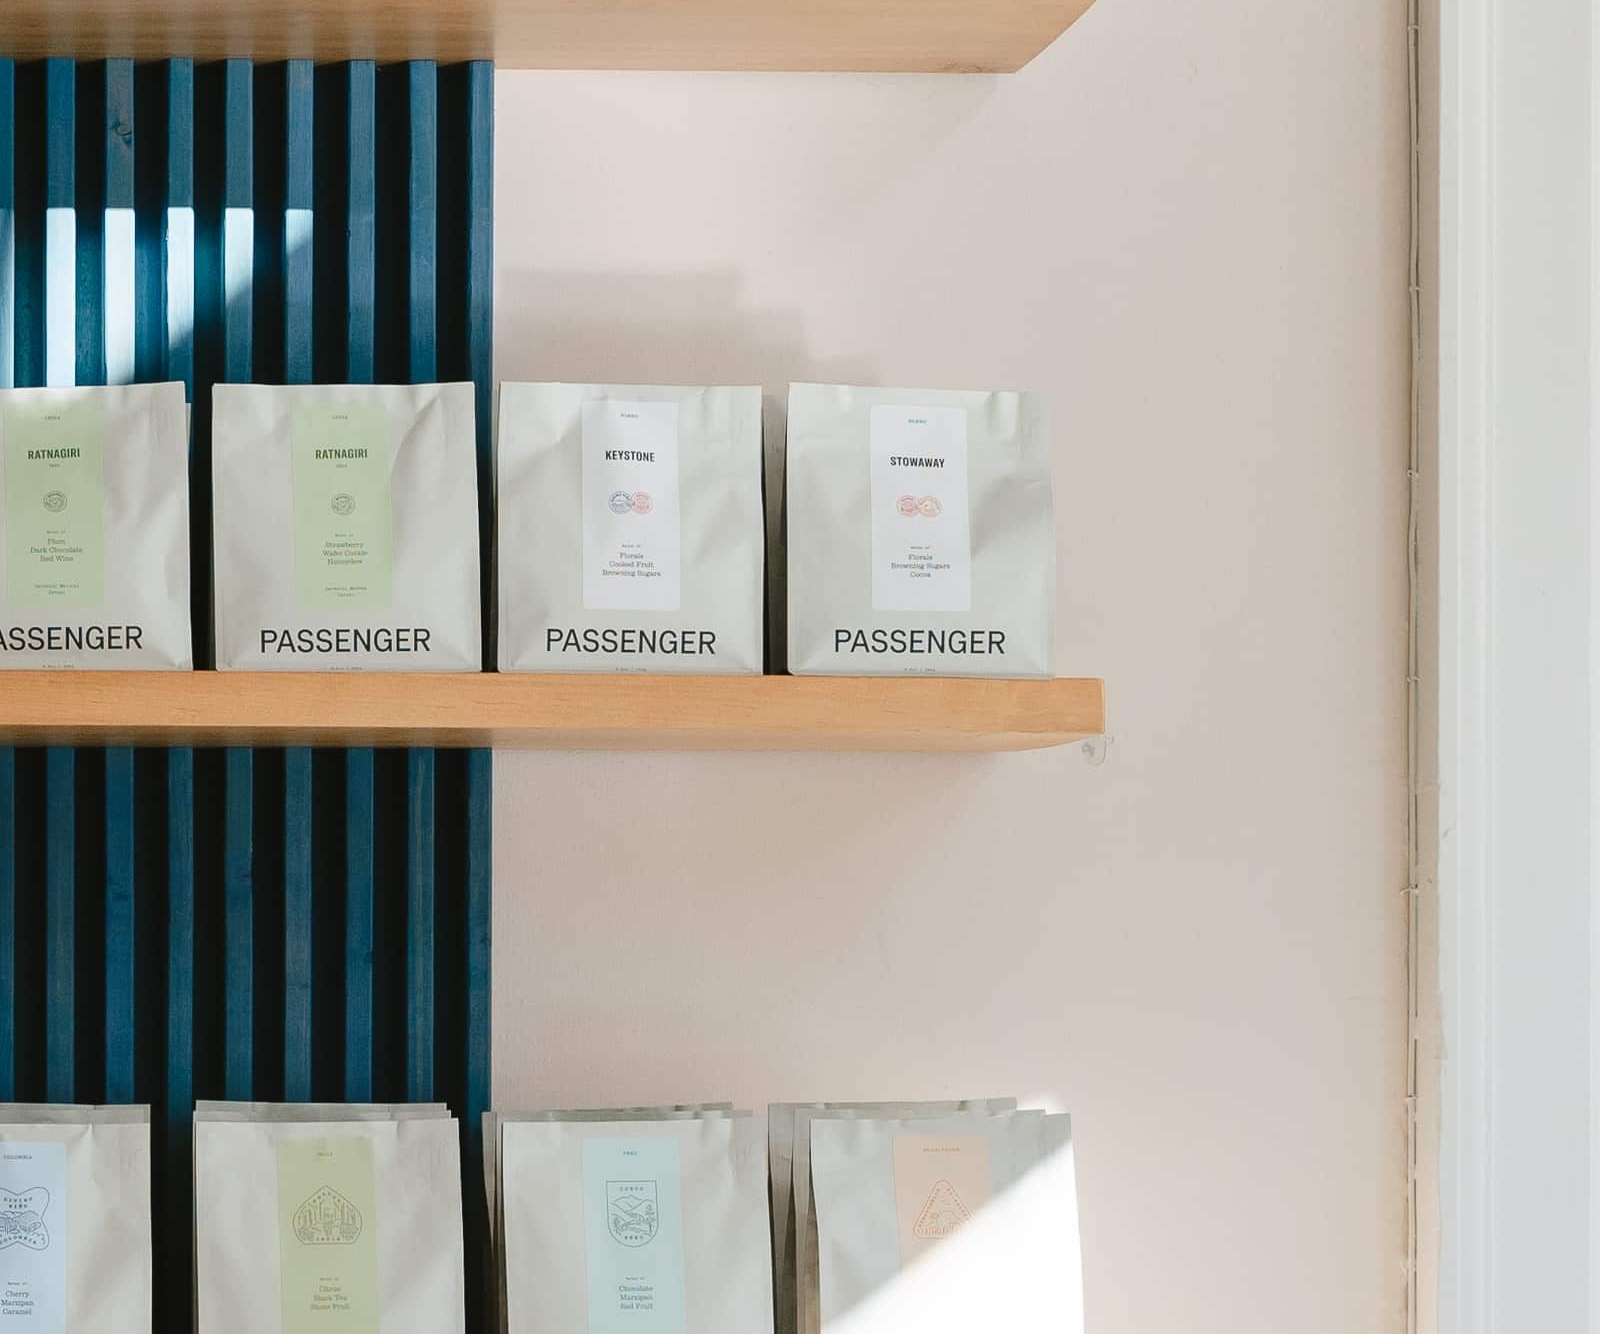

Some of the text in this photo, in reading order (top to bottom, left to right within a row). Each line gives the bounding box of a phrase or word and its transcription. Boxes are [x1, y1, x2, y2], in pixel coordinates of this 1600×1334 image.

[28, 448, 80, 460] RATNAGIRI
[315, 449, 368, 459] RATNAGIRI
[605, 450, 655, 462] KEYSTONE
[890, 456, 945, 468] STOWAWAY
[261, 629, 430, 652] PASSENGER
[547, 629, 715, 654] PASSENGER
[835, 629, 1005, 654] PASSENGER
[5, 1290, 29, 1298] Cherry
